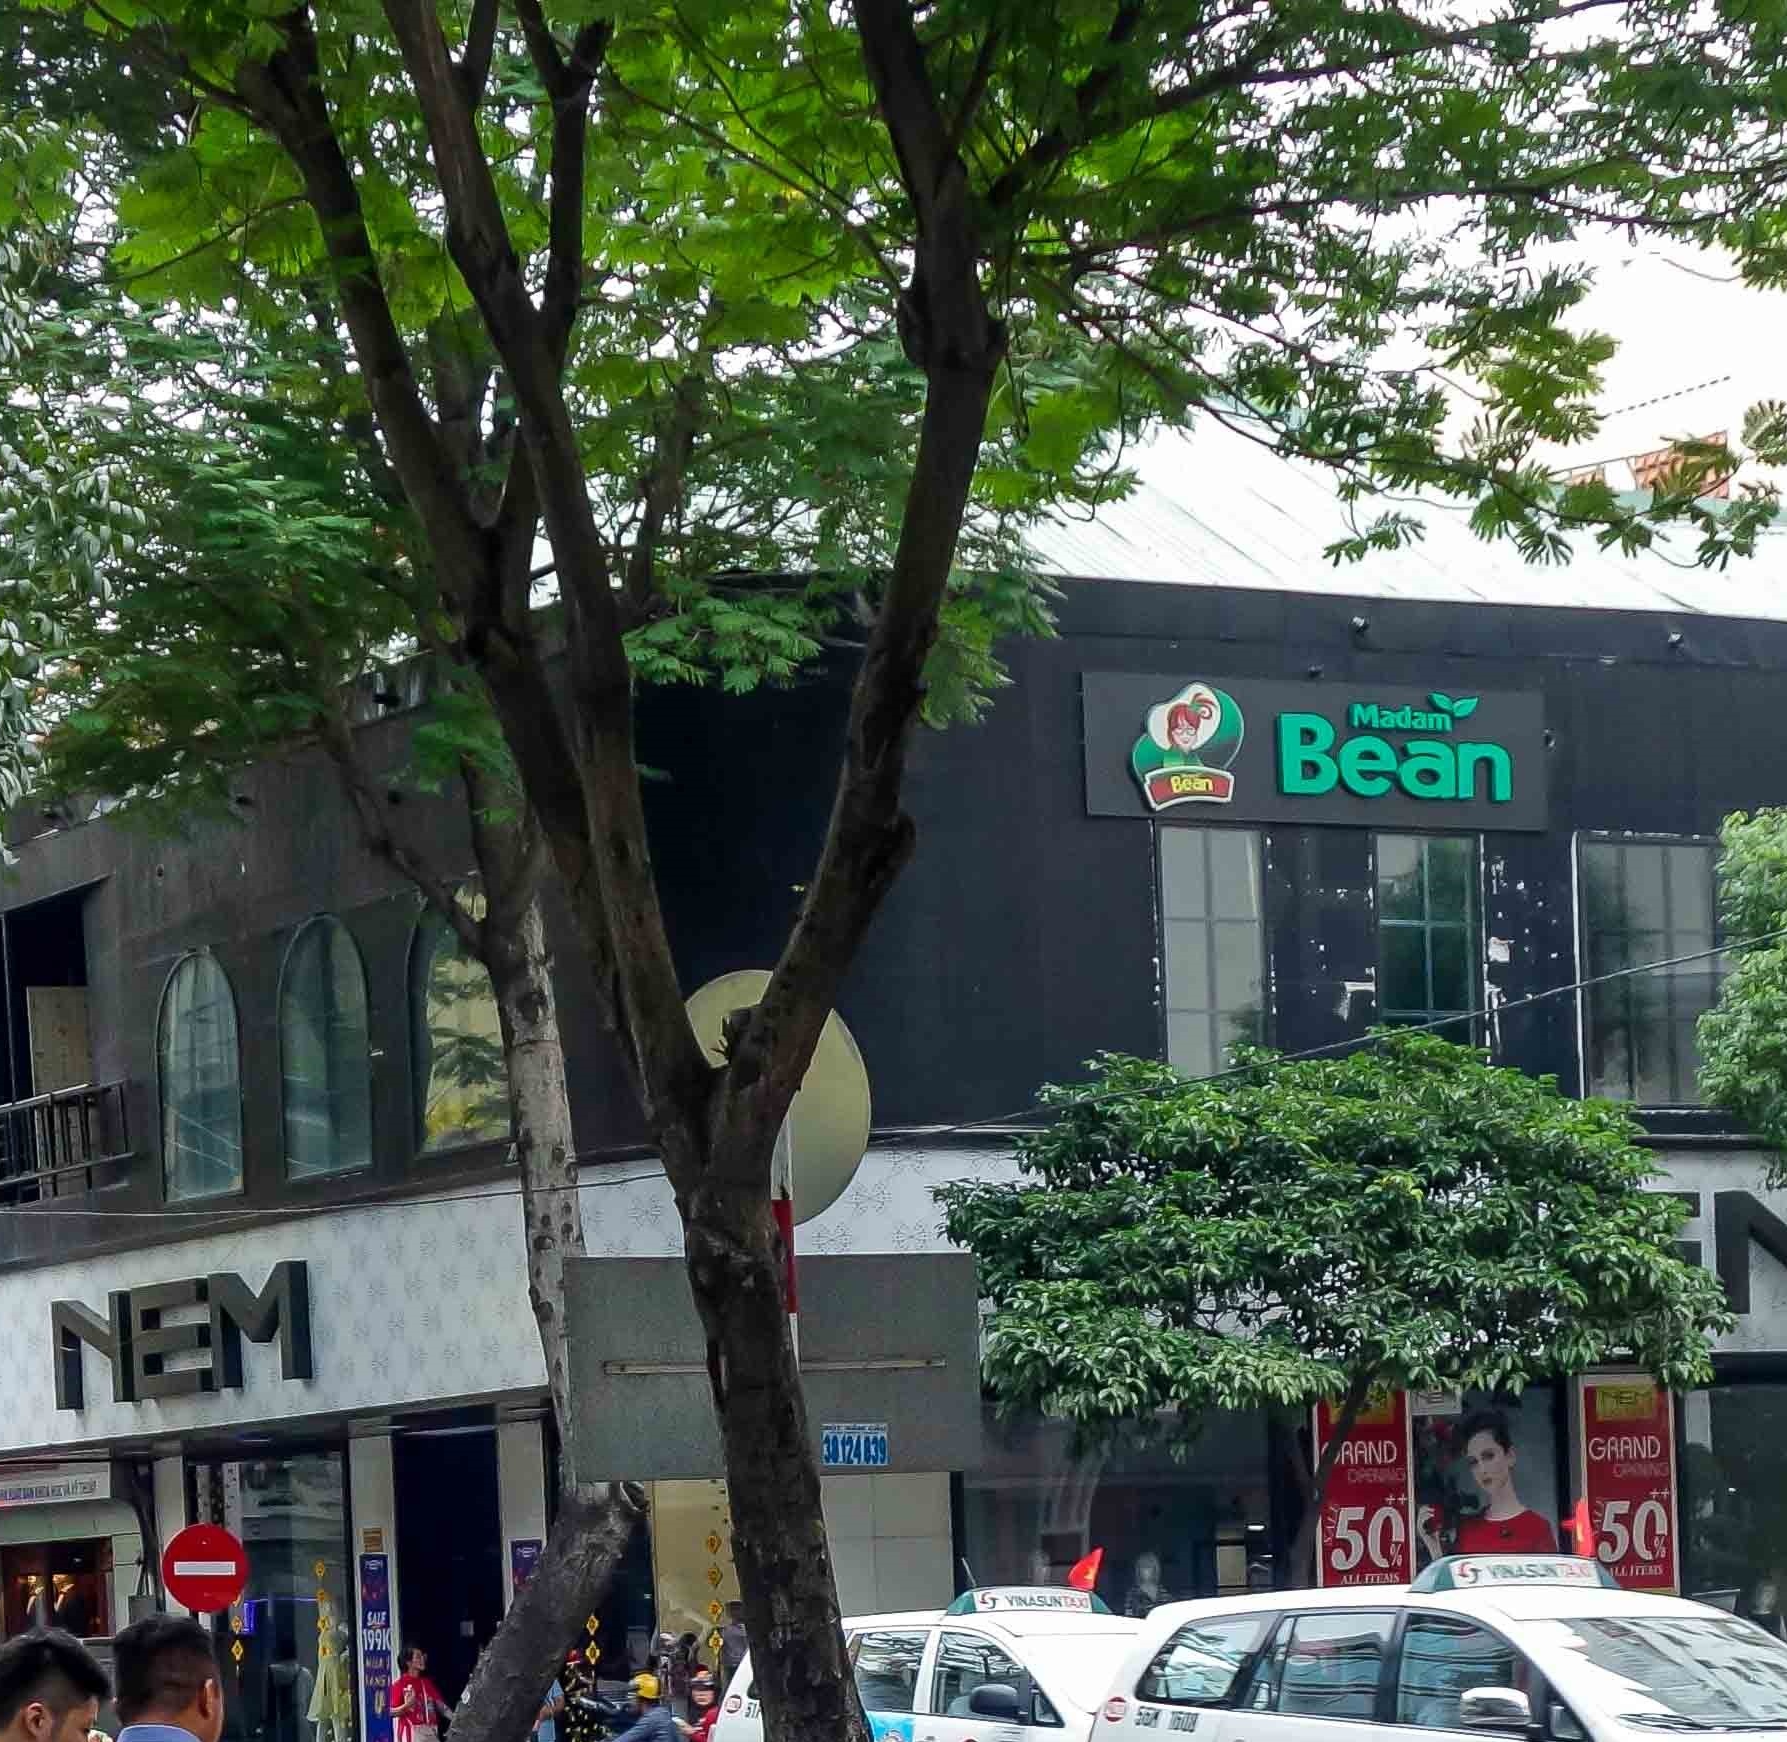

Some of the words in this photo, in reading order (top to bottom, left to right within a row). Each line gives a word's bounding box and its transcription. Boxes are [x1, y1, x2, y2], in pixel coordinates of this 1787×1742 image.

[1349, 702, 1453, 731] Madam
[1277, 711, 1512, 801] Bean
[1170, 774, 1214, 793] Bean
[51, 1258, 313, 1411] NEM
[1588, 1435, 1661, 1461] GRAND
[1340, 1575, 1365, 1586] ALL
[1366, 1573, 1400, 1585] ITEMS
[1004, 1592, 1090, 1610] VINASUNTAXI
[367, 1611, 387, 1627] SALE
[363, 1628, 392, 1651] 199K
